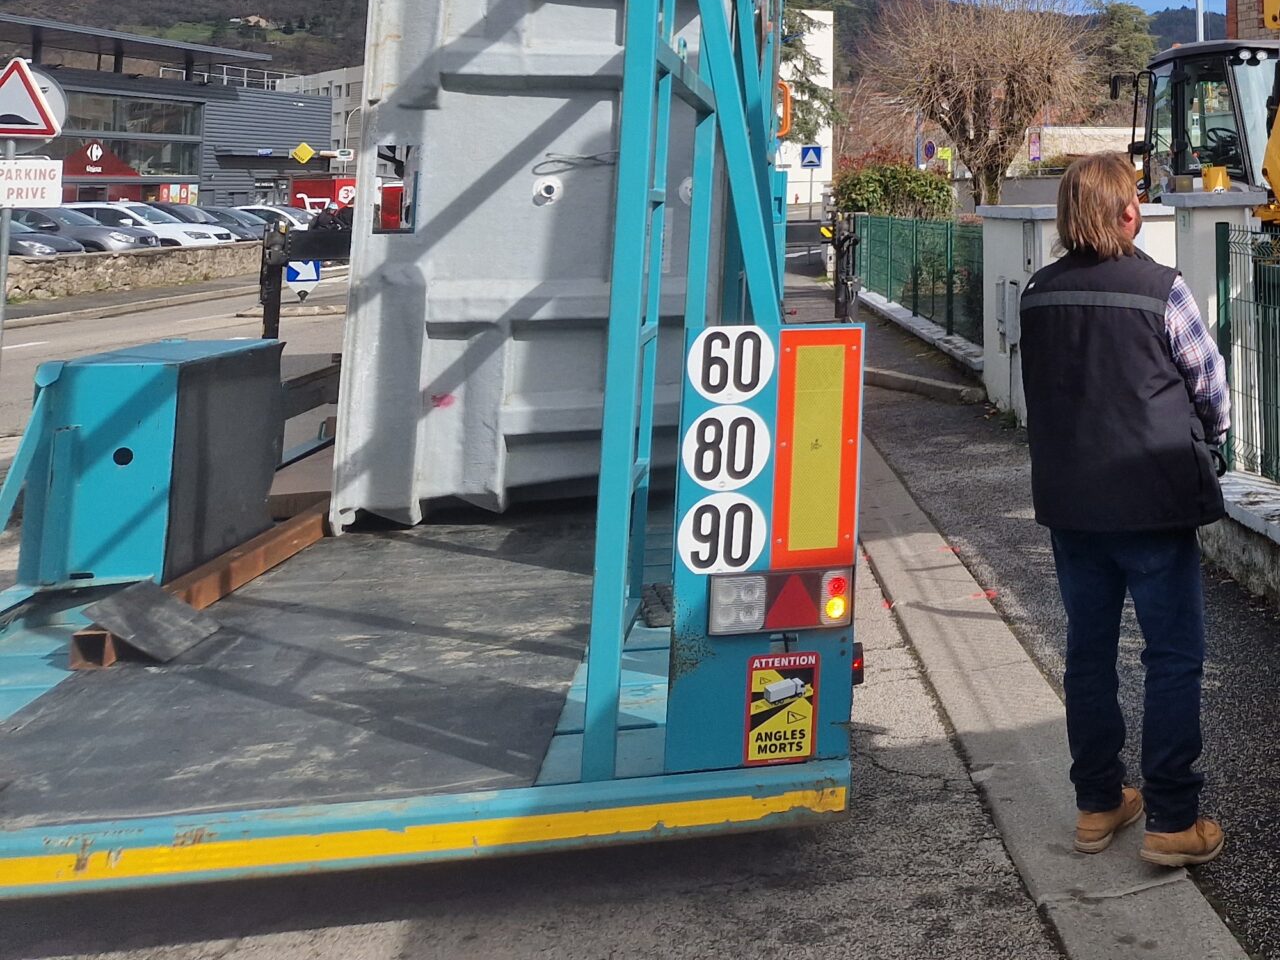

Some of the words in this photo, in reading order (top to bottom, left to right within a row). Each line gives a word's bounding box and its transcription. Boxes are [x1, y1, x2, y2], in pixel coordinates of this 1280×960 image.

[701, 330, 761, 394] 60
[694, 416, 756, 482] 80
[690, 502, 753, 570] 90
[753, 656, 816, 669] ATTENTION
[755, 728, 806, 742] ANGLES
[757, 741, 803, 755] MORTS
